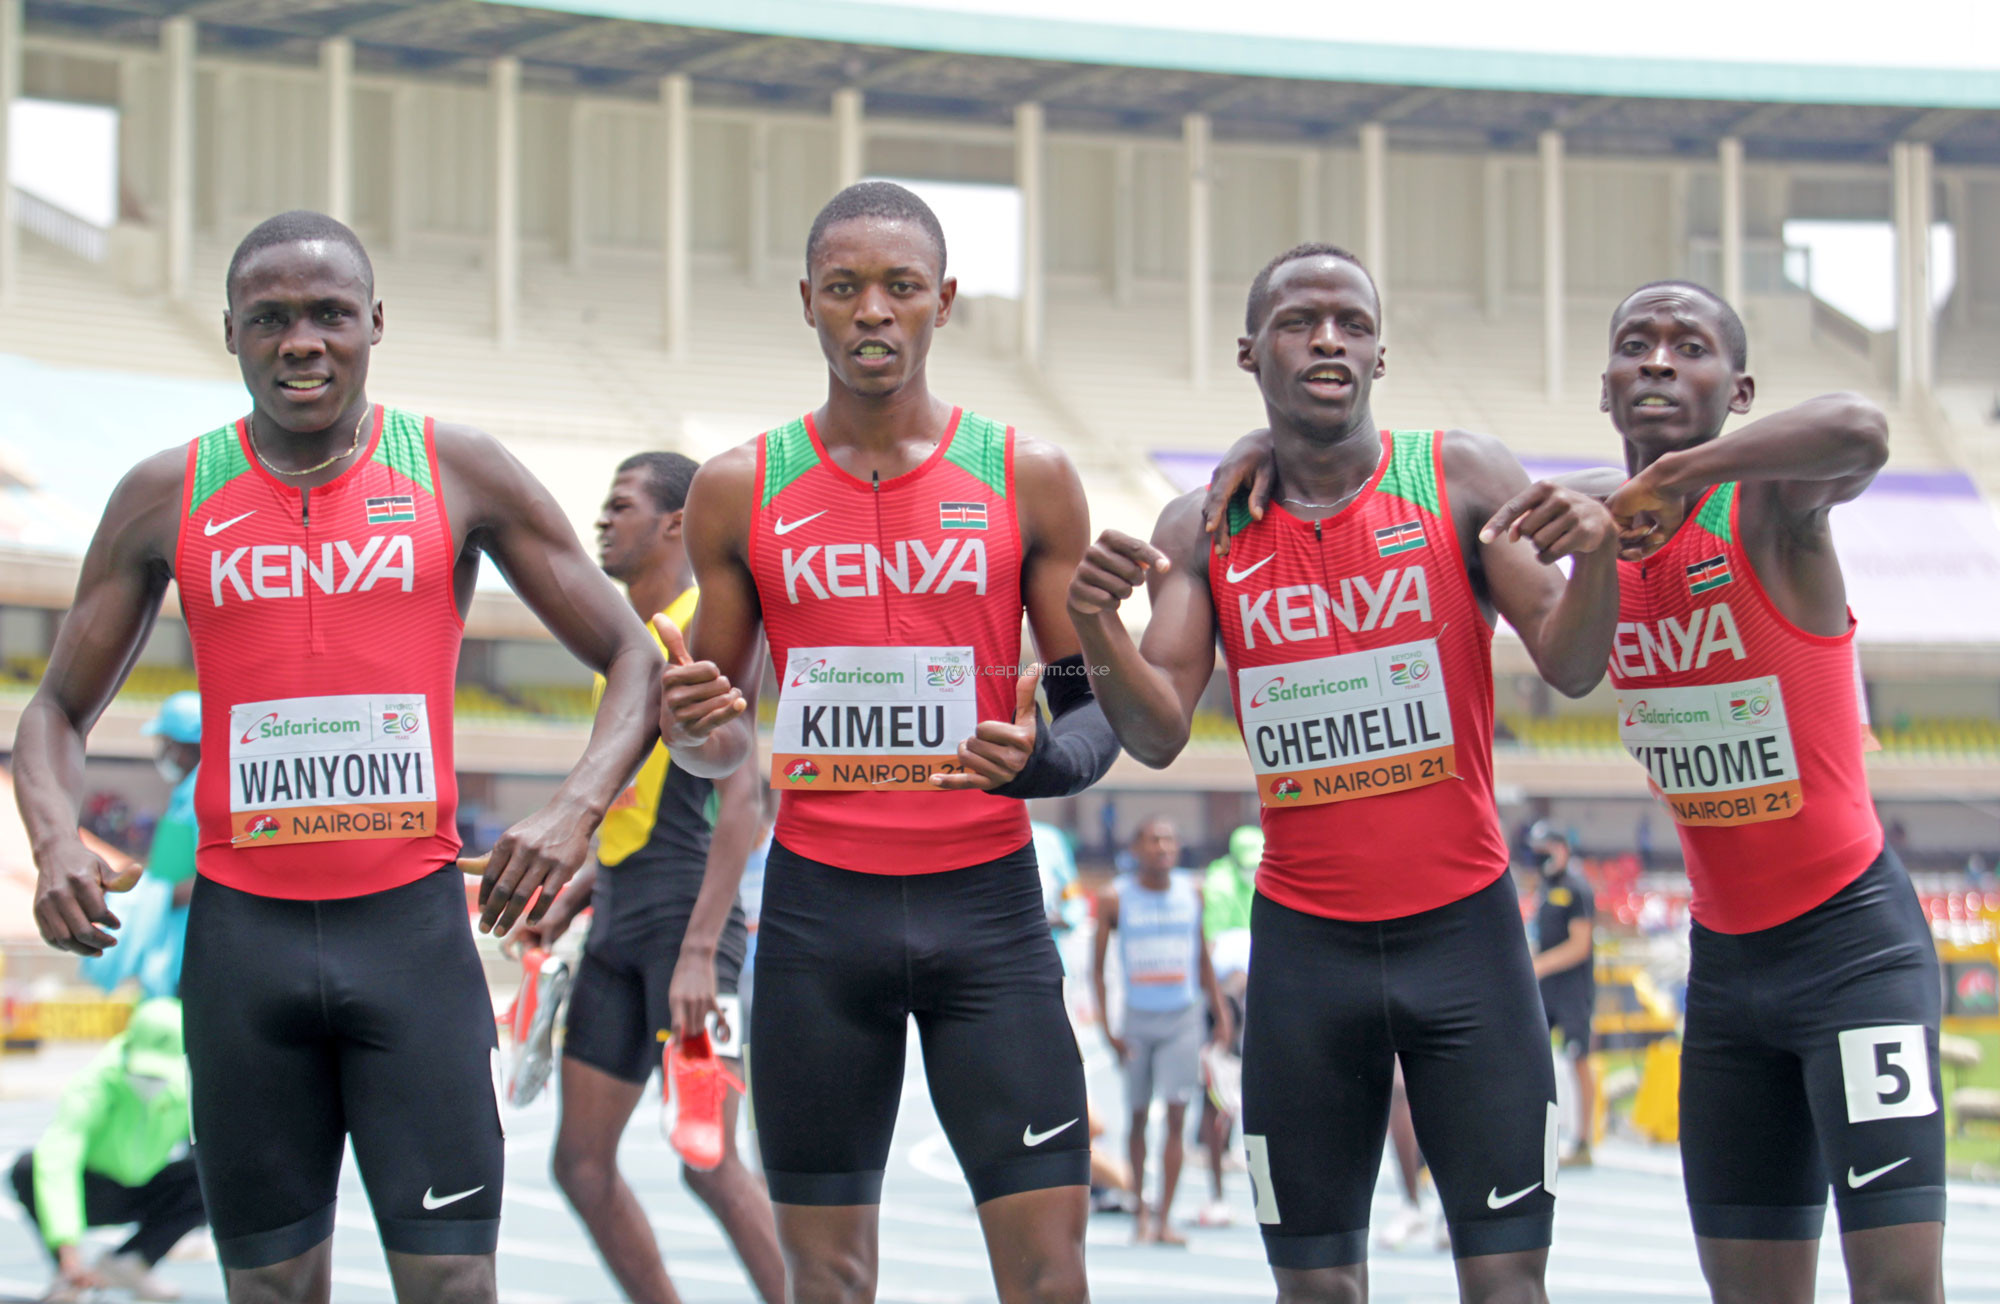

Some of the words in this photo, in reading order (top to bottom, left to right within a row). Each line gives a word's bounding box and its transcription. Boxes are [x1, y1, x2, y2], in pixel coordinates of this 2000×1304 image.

[210, 535, 415, 607] KENYA
[782, 538, 987, 604] KENYA
[1239, 565, 1432, 649] KENYA
[1609, 602, 1747, 679] ENYA
[809, 667, 905, 685] Safaricom
[1267, 675, 1369, 703] Safaricom
[1389, 660, 1431, 686] 20
[260, 717, 361, 738] Safaricom
[382, 712, 420, 735] 20
[801, 705, 945, 748] KIMEU
[1638, 707, 1710, 725] Safaricom
[1256, 700, 1441, 768] CHEMELIL
[239, 752, 424, 804] WANYONYI
[833, 764, 932, 783] NAIROBI
[1314, 763, 1412, 796] NAIROBI
[1419, 756, 1445, 779] 21
[1671, 797, 1757, 820] NAIROBI
[1764, 790, 1791, 812] 21
[293, 813, 392, 835] NAIROBI
[401, 811, 426, 830] 21
[1873, 1041, 1911, 1105] 5
